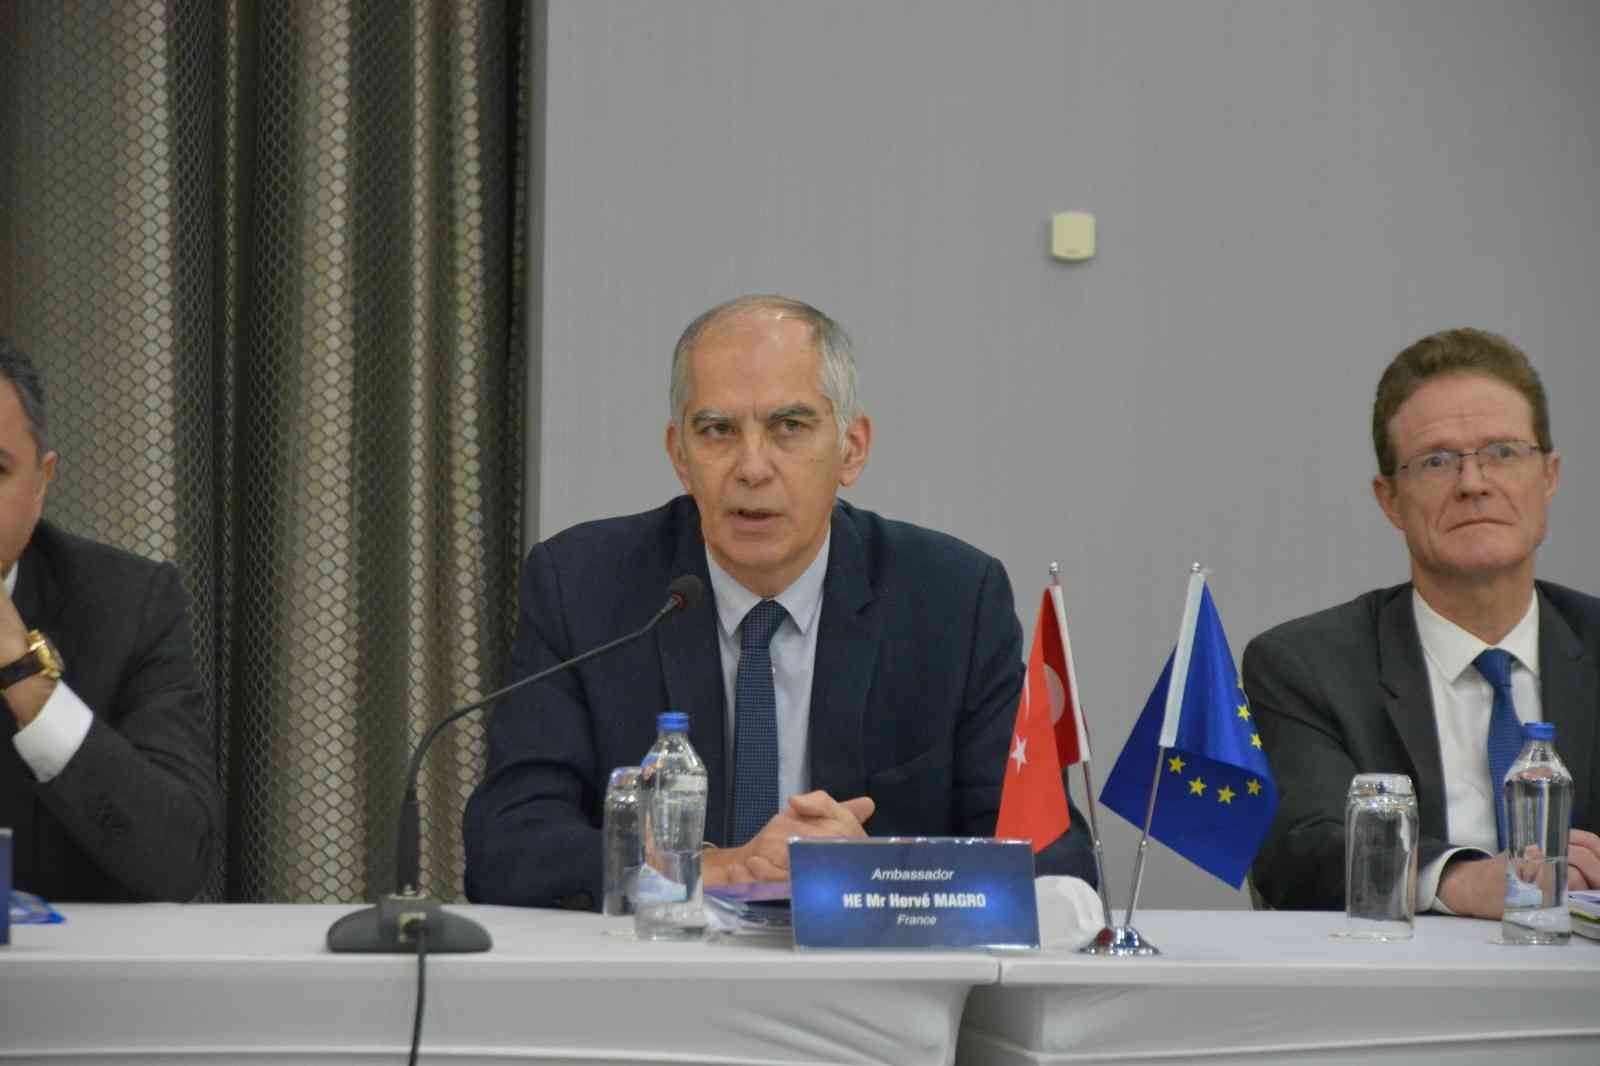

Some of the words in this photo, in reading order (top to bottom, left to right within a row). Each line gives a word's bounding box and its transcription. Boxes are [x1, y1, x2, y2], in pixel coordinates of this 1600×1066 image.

[871, 868, 955, 881] Ambassador
[843, 893, 863, 908] HE
[866, 893, 885, 908] Mr
[890, 892, 930, 908] Hervé
[935, 893, 986, 908] MAGRO
[896, 914, 937, 926] France
